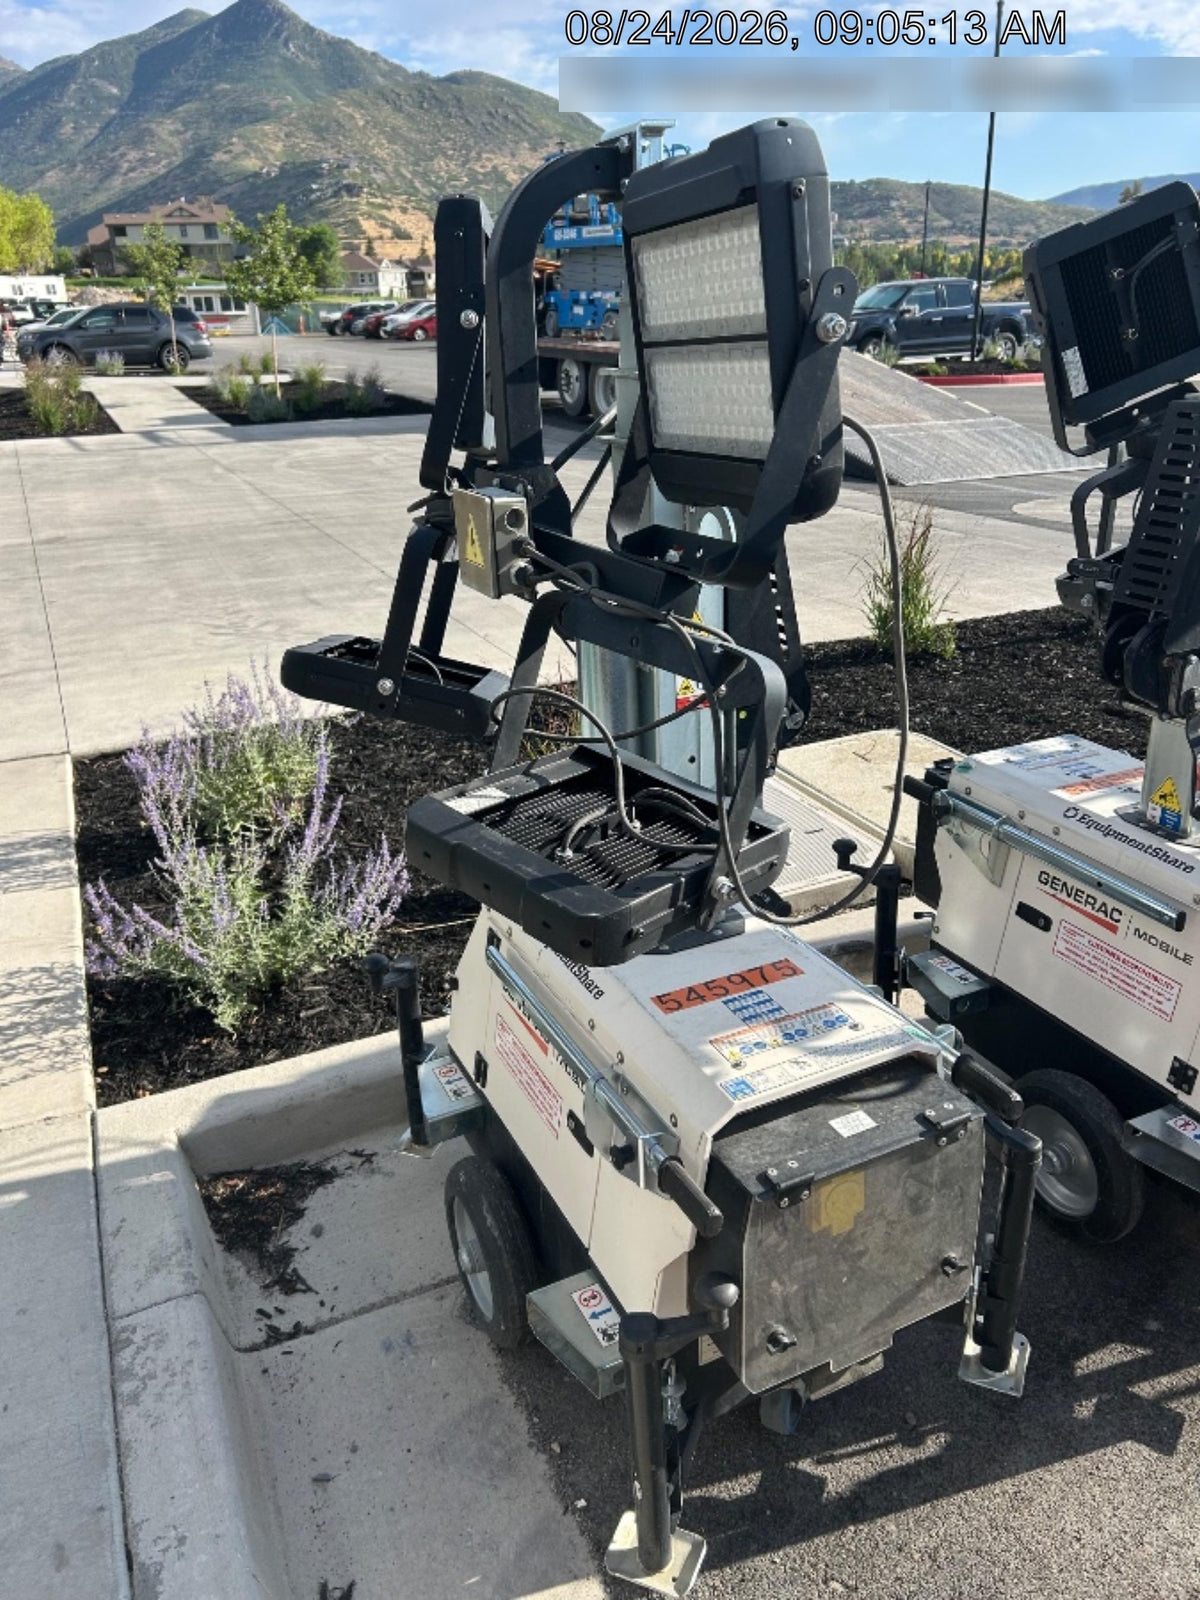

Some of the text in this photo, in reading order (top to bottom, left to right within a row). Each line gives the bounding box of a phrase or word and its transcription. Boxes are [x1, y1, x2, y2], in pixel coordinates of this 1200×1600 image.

[1076, 813, 1195, 873] EquipmentShare
[1037, 870, 1123, 924] GENERAC
[1133, 927, 1194, 967] MOBILE
[656, 957, 798, 1011] 545975
